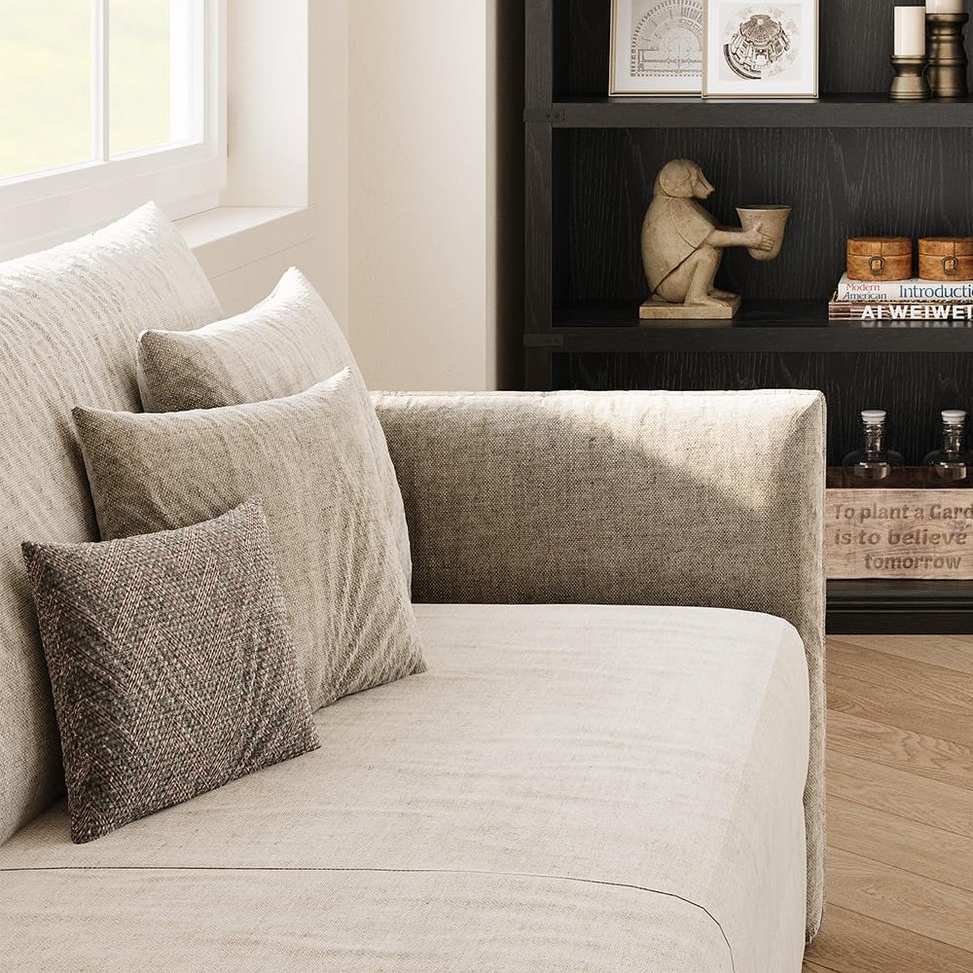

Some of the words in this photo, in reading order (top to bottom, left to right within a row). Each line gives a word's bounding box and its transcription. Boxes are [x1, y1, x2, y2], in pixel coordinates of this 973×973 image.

[846, 283, 880, 292] Modern
[843, 291, 887, 300] American
[861, 304, 882, 319] AI
[888, 304, 973, 319] WEIWEI
[832, 504, 855, 520] To
[859, 504, 910, 523] plant
[914, 509, 924, 520] a
[834, 529, 851, 545] is
[858, 529, 881, 545] to
[888, 529, 967, 545] believe
[864, 554, 962, 570] tomorrow
